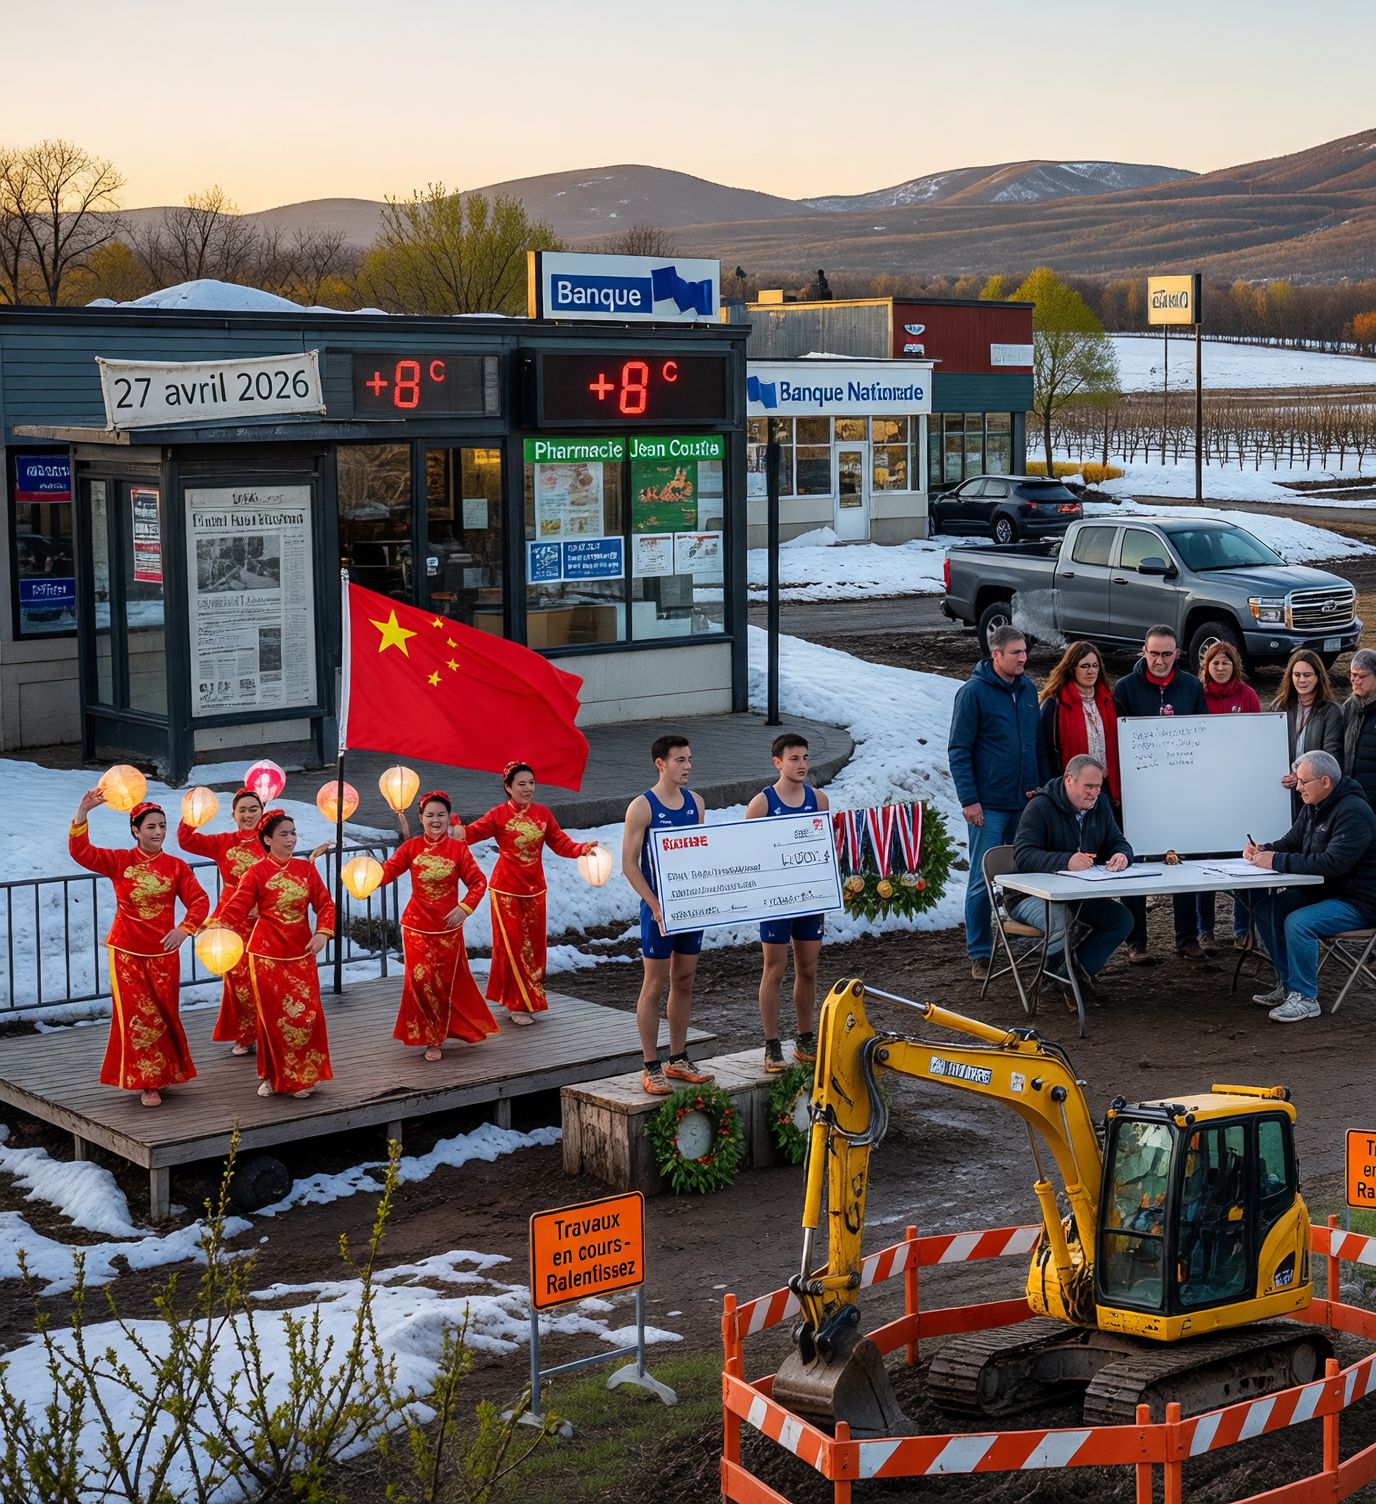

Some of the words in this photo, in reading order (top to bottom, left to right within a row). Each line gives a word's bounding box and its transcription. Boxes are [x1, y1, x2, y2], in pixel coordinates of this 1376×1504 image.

[557, 280, 642, 312] Banque
[114, 377, 151, 409] 27
[164, 371, 227, 406] avril
[236, 369, 309, 402] 2026
[780, 381, 844, 407] Banque
[535, 441, 623, 460] Pharmacie
[630, 439, 665, 458] Jean
[554, 1212, 621, 1241] Travaux
[552, 1249, 573, 1267] en
